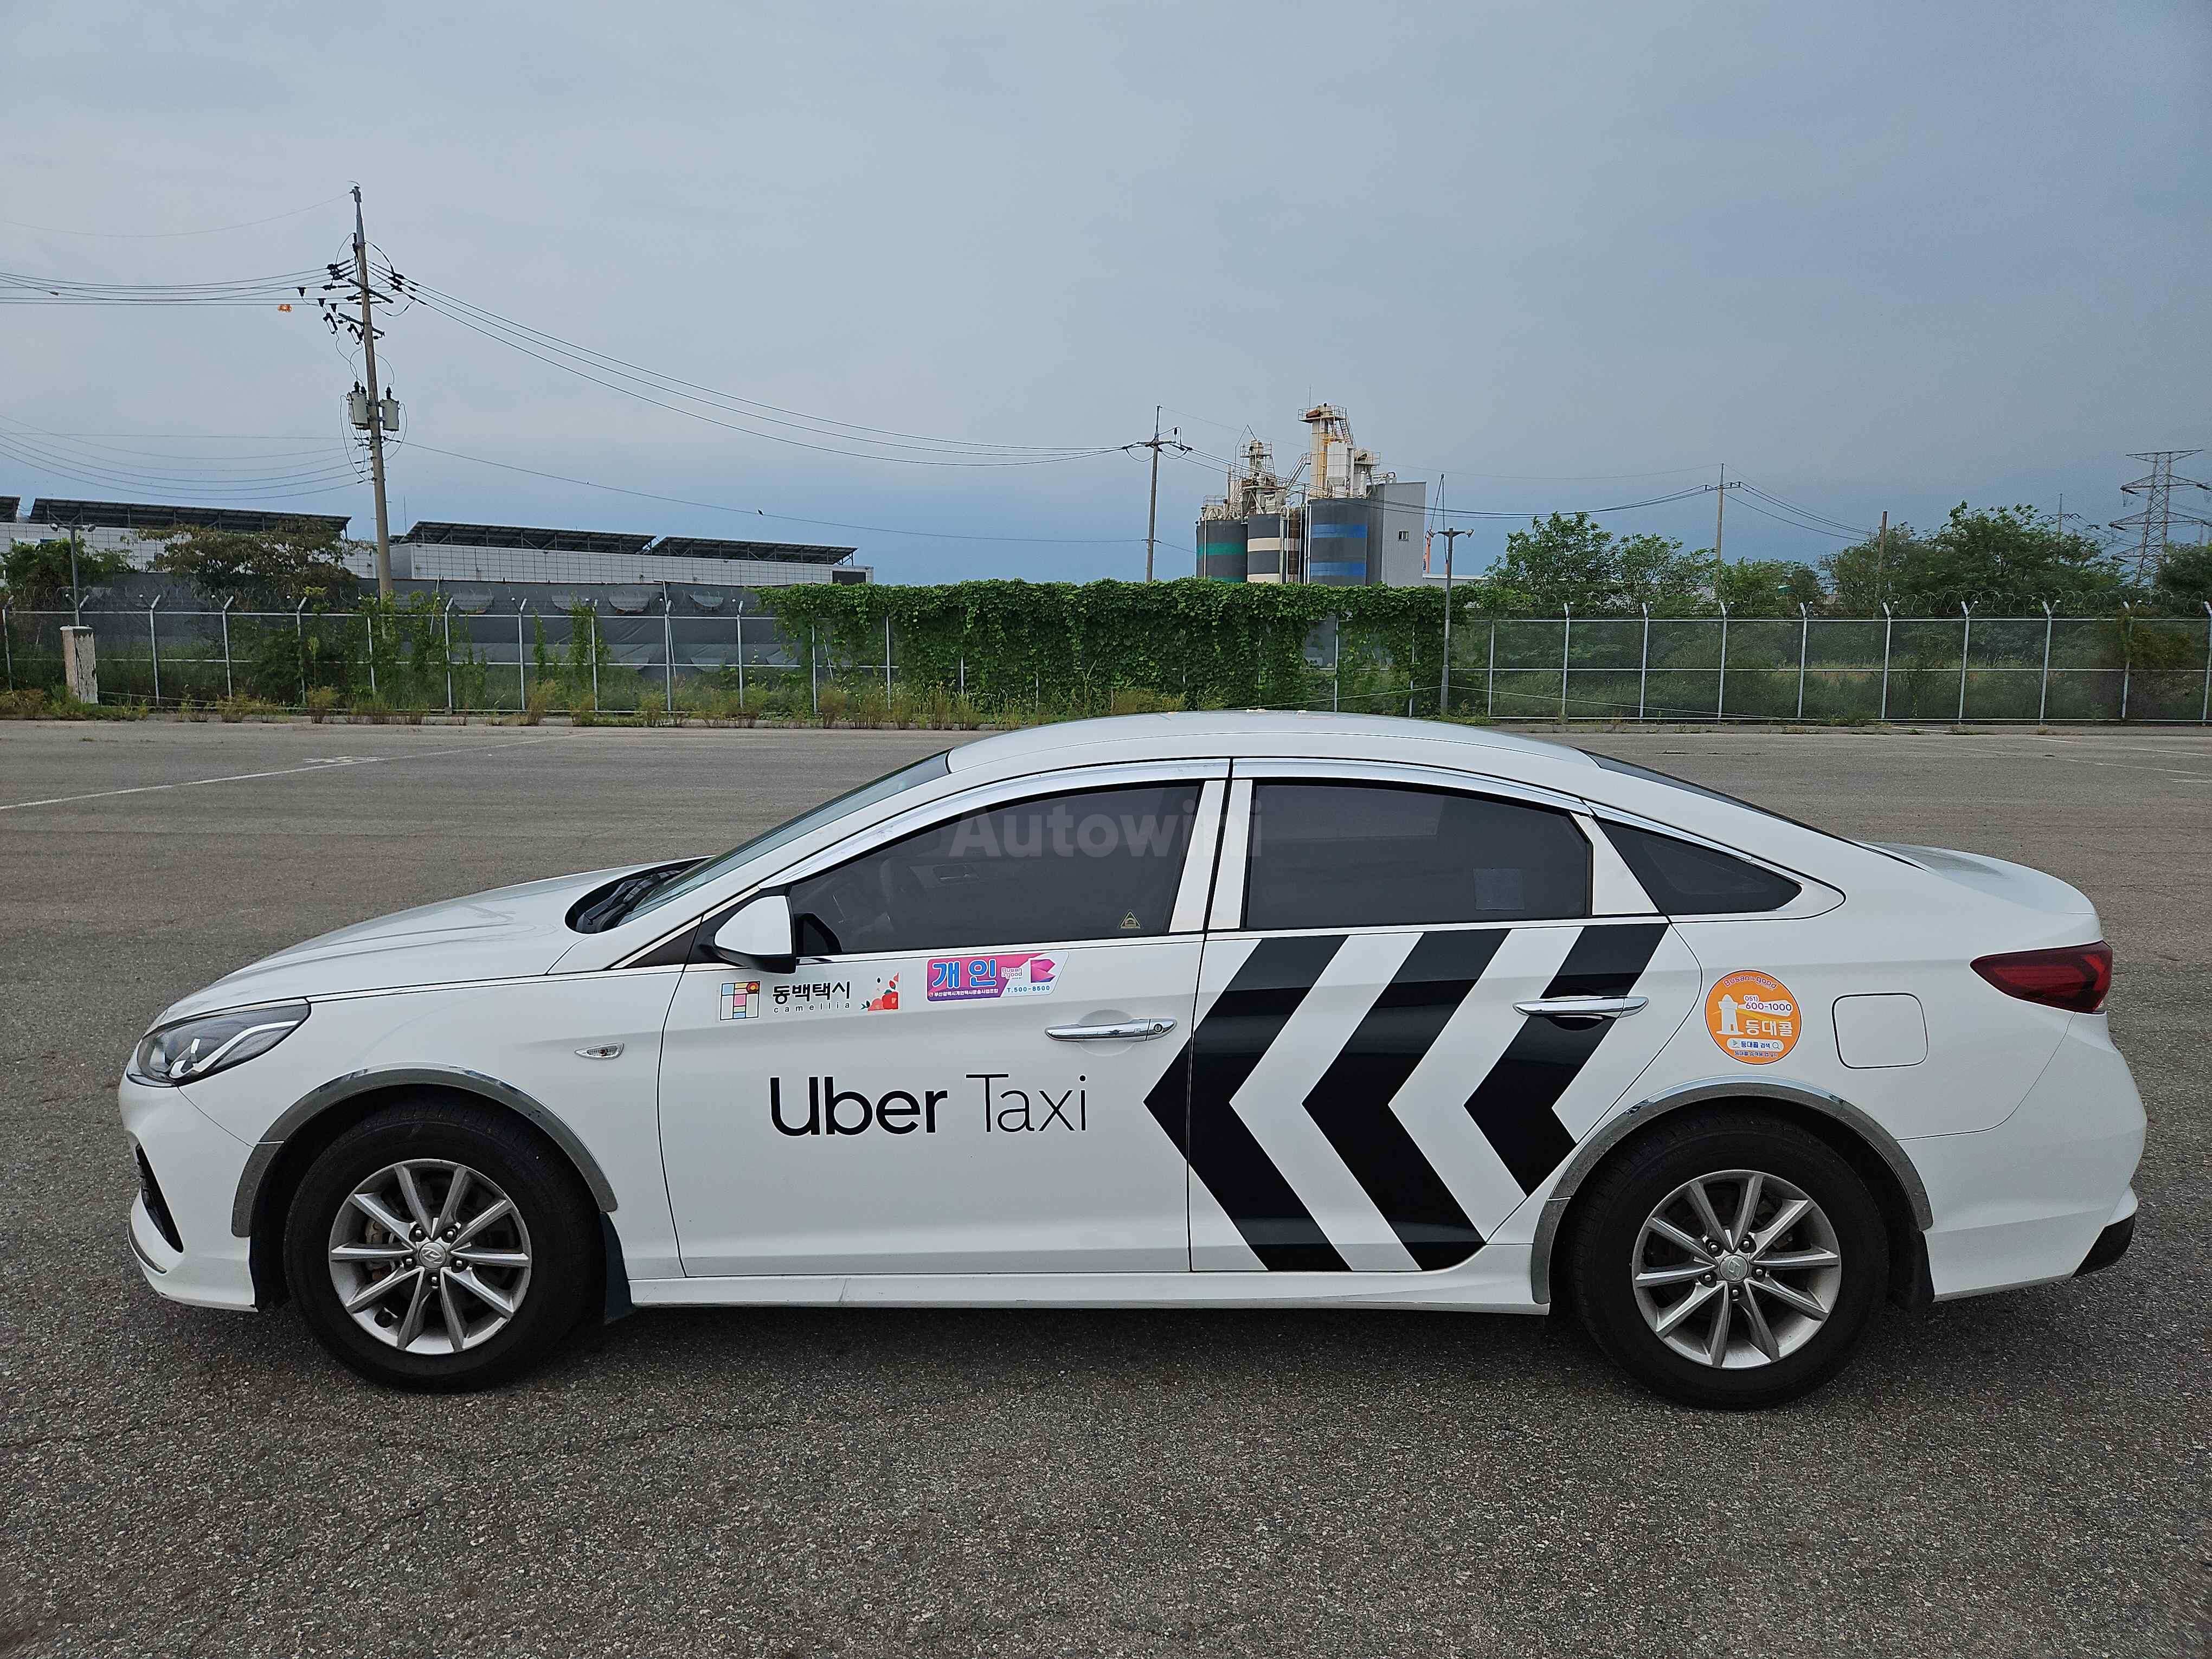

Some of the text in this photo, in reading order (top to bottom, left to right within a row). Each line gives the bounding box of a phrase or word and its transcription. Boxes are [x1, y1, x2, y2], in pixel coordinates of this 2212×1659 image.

[1724, 976, 1750, 987] Busan
[1756, 976, 1778, 989] good
[772, 981, 851, 1005] 동백택시
[774, 1001, 850, 1013] camellia
[1745, 1002, 1792, 1011] 600-1000
[1745, 1020, 1793, 1037] 등대콜
[769, 1073, 1087, 1136] Uber Taxi
